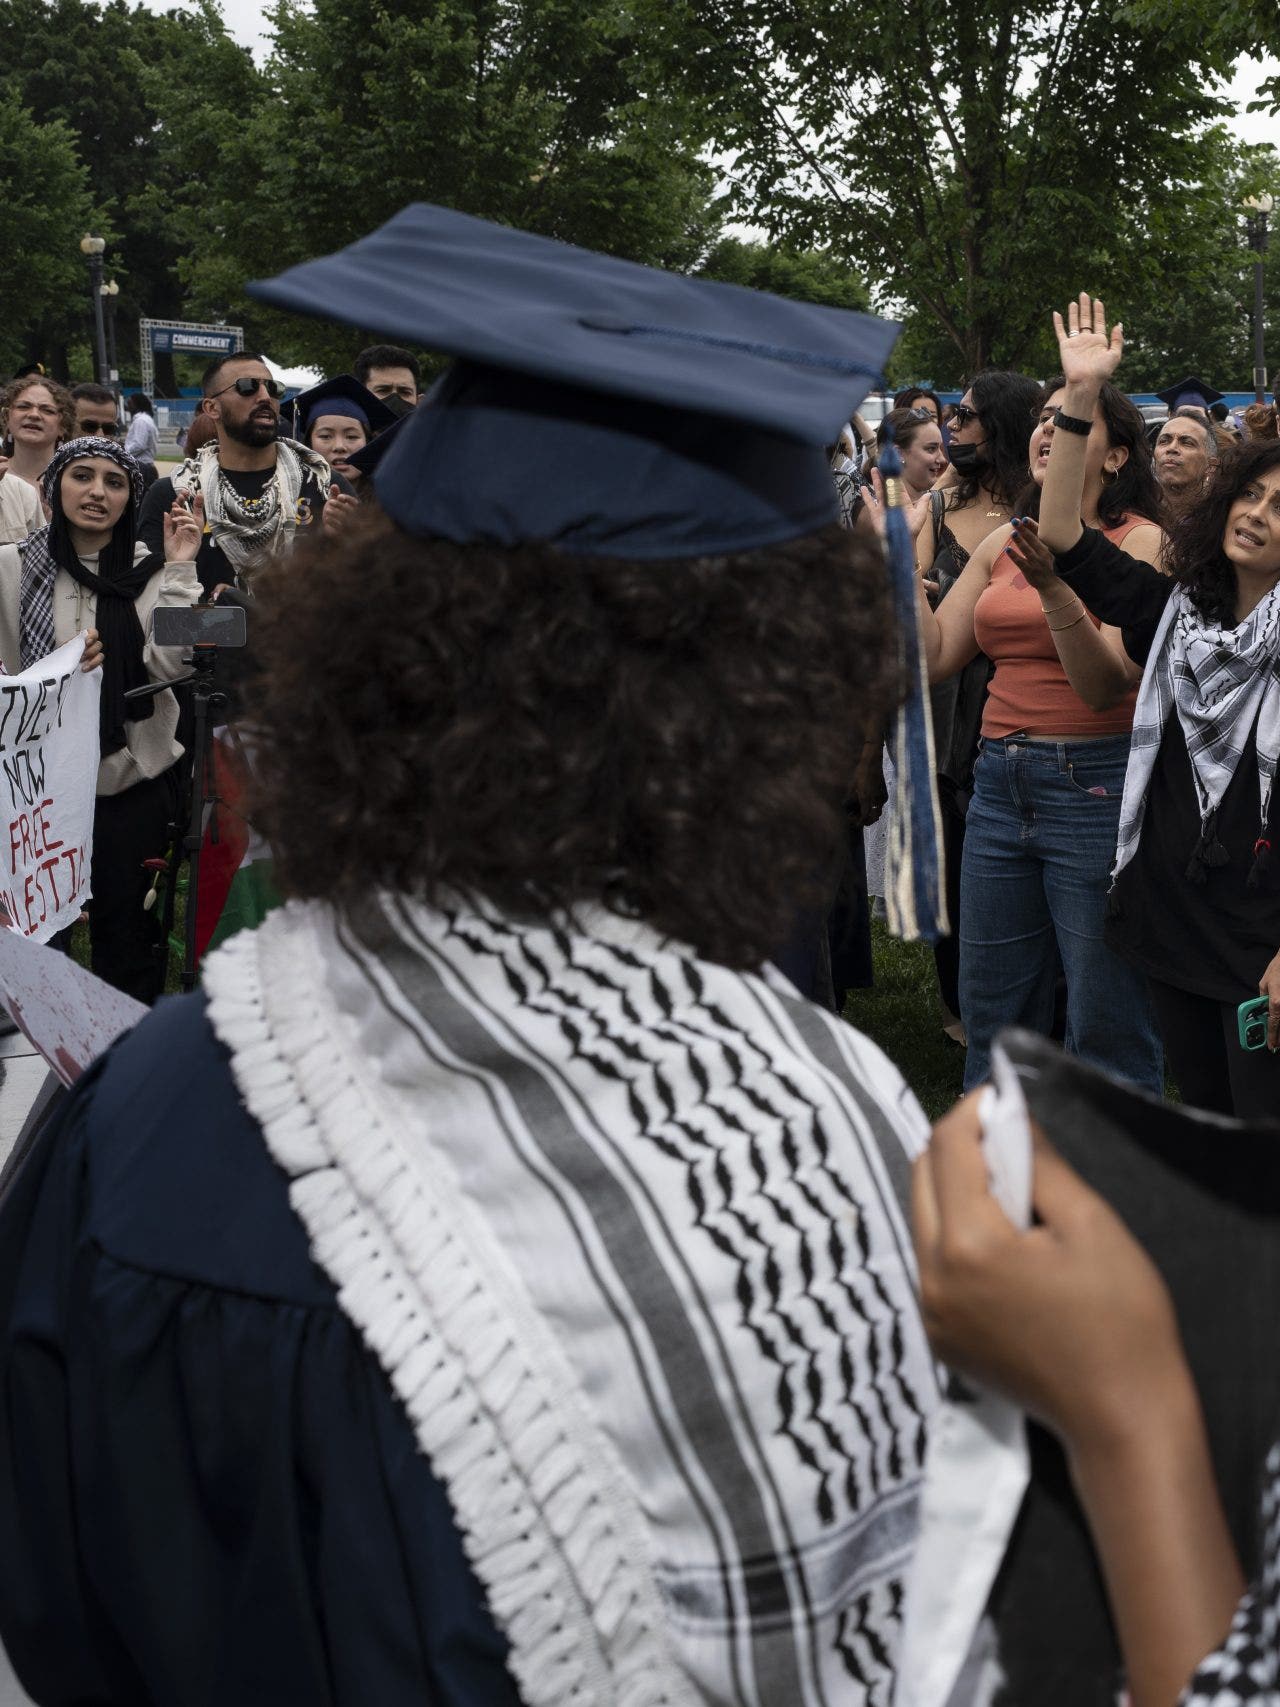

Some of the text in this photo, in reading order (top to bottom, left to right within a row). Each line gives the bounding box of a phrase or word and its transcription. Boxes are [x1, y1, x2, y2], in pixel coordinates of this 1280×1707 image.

[172, 334, 231, 349] COMMENCEMENT
[3, 746, 45, 810] NOW
[10, 798, 64, 875] FREE
